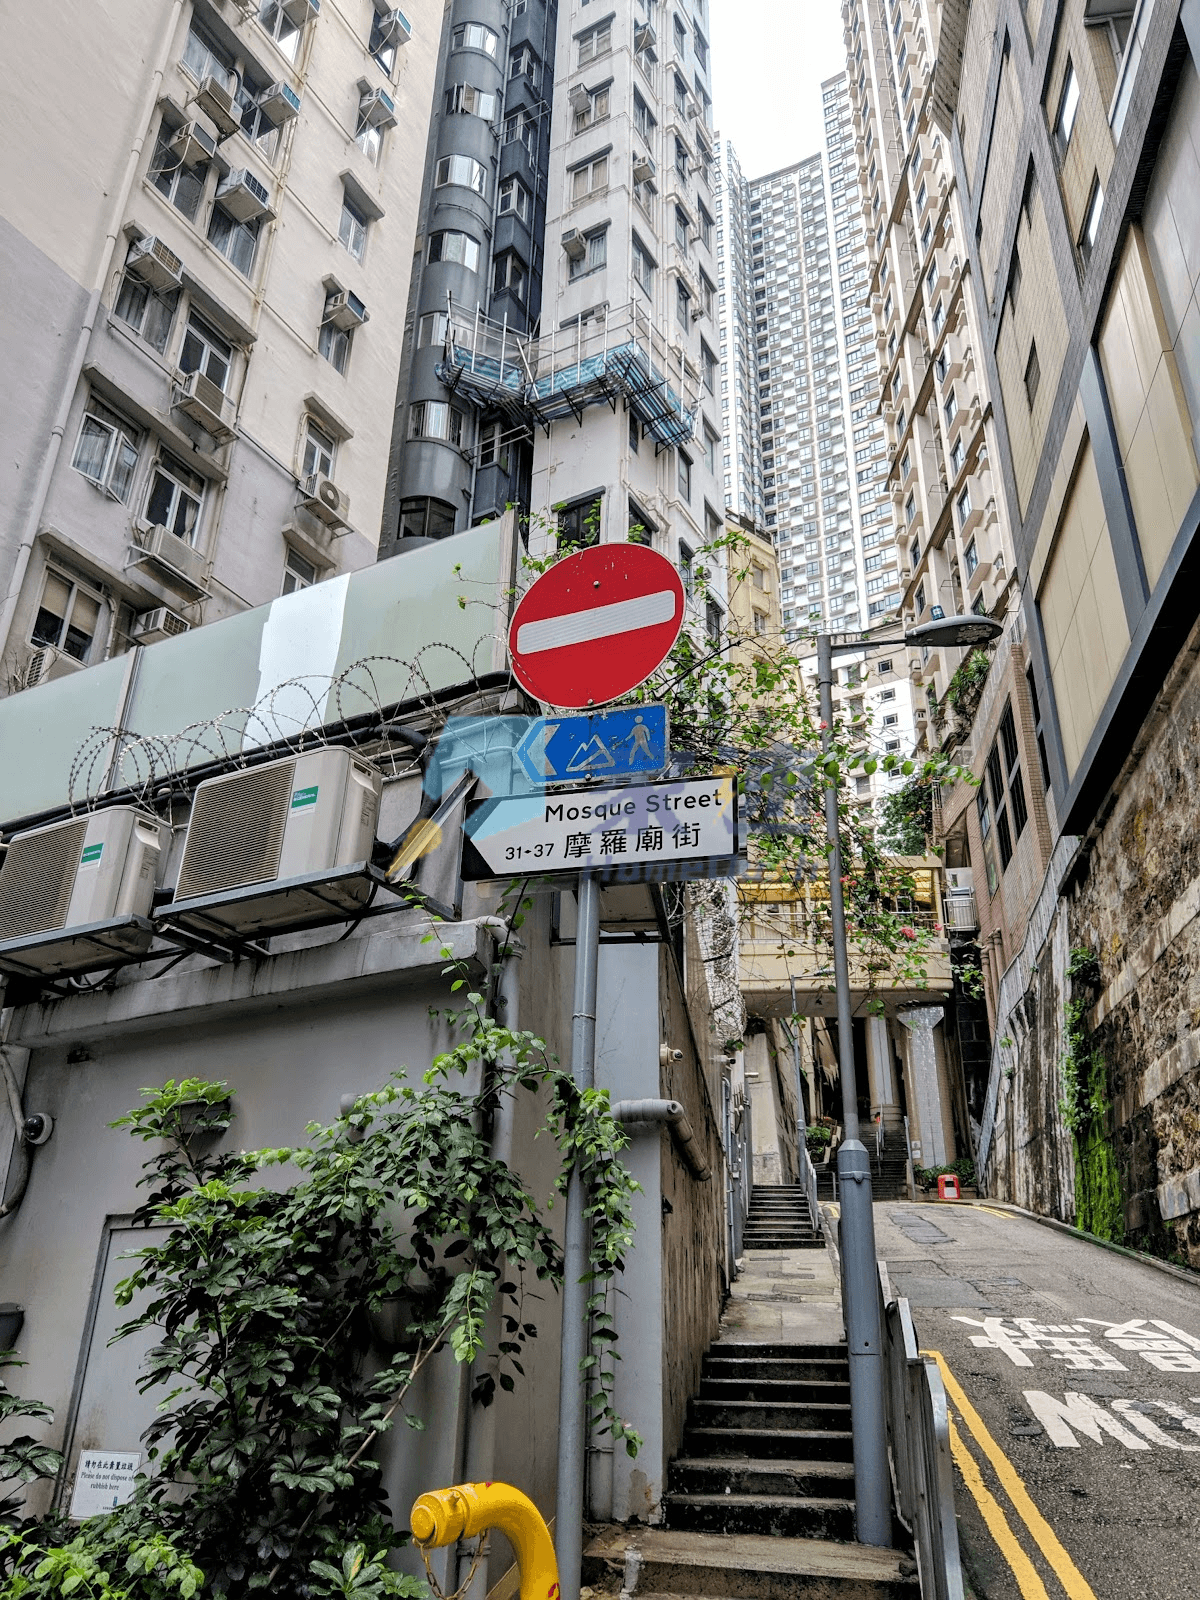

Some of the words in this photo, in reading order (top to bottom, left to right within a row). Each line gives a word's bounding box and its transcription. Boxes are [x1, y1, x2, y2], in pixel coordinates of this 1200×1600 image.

[545, 800, 636, 823] Mosque
[646, 788, 722, 813] Street
[505, 843, 555, 861] 31-37
[563, 822, 701, 859] 摩羅廟街
[81, 1471, 95, 1479] Please
[111, 1474, 128, 1482] dispose
[90, 1482, 108, 1490] rubbish
